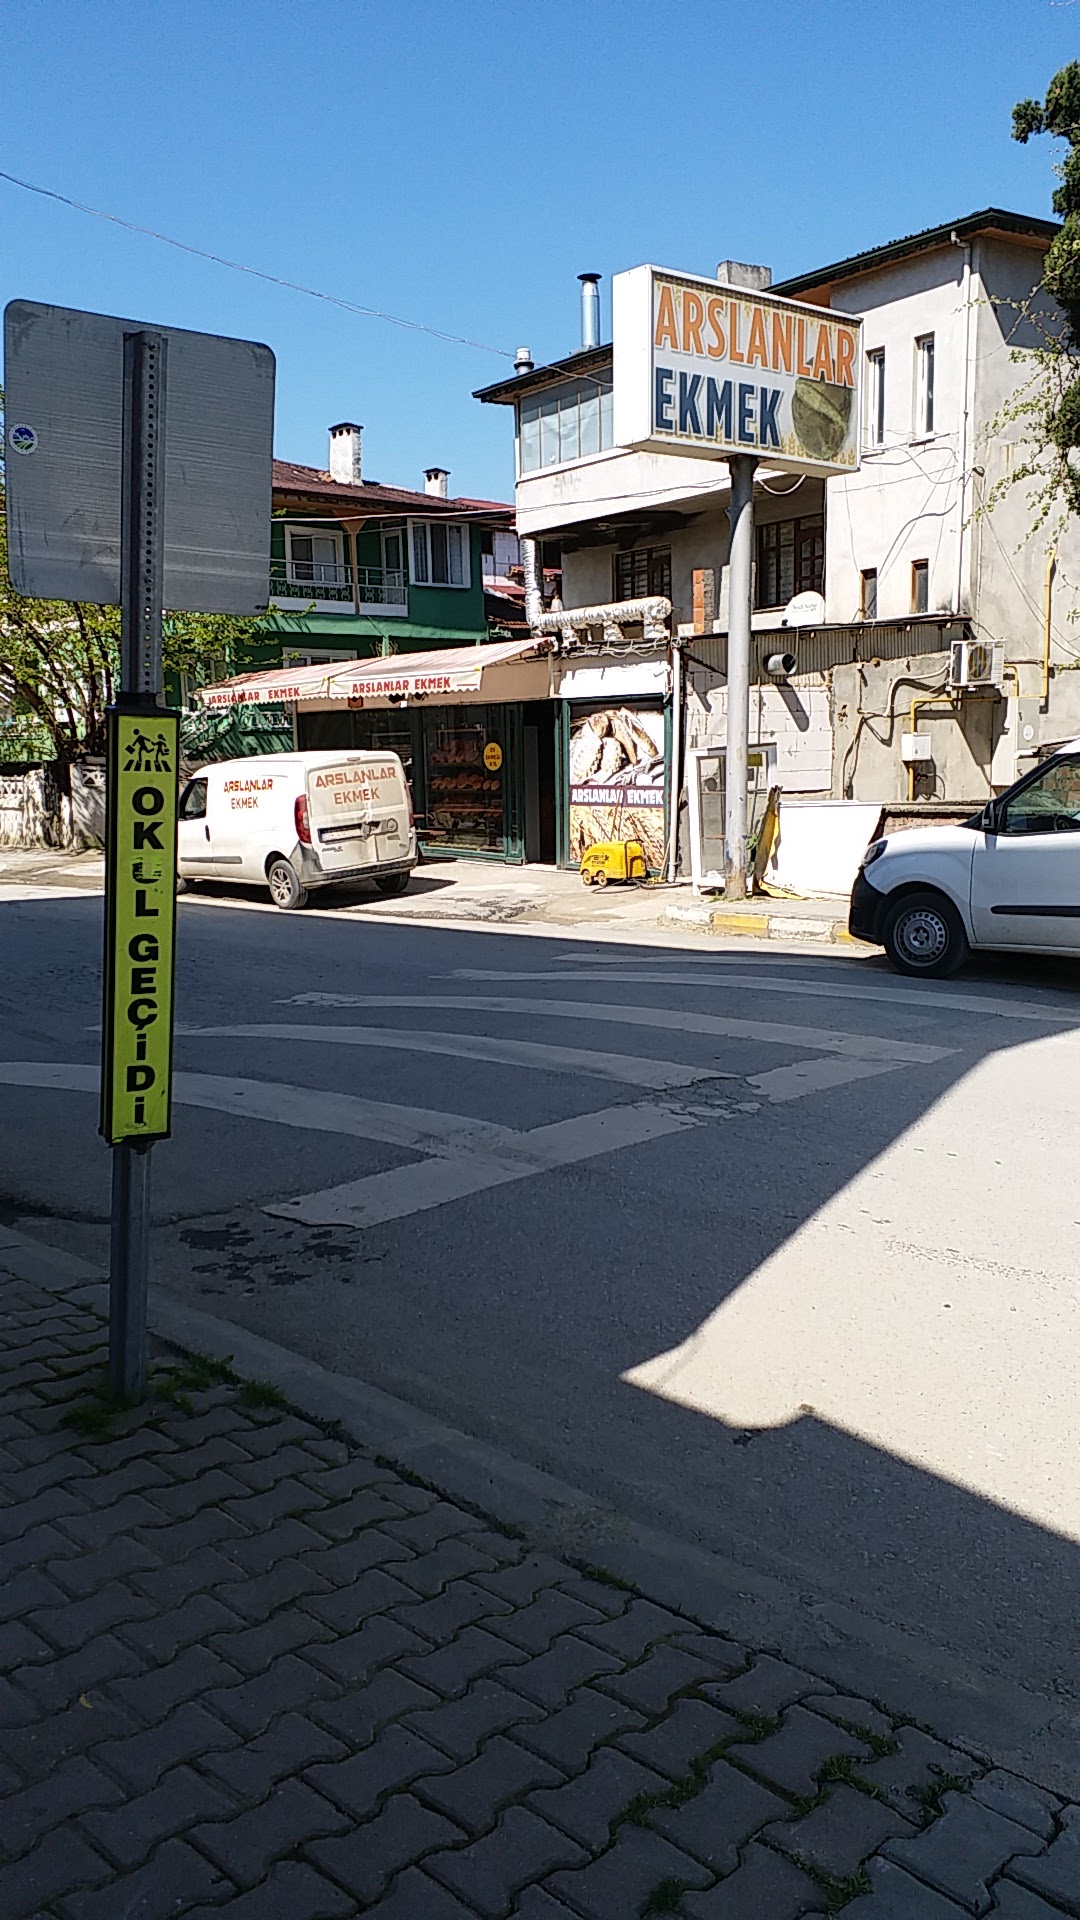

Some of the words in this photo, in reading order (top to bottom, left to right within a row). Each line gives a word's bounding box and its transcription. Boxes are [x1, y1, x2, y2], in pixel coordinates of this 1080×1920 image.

[654, 284, 857, 389] ARSLANLAR
[654, 366, 782, 448] EKMEK
[351, 679, 410, 694] ARSLANLAR
[414, 676, 451, 690] EKMEK
[210, 691, 260, 704] ARSLANLAR
[267, 686, 301, 700] EKMEK
[223, 778, 274, 793] ARSLANLAR
[315, 766, 397, 789] ARSLANLAR
[230, 796, 259, 810] EKMEK
[333, 786, 381, 805] EKMEK
[626, 789, 664, 805] EKMEK
[131, 786, 165, 918] OKUL
